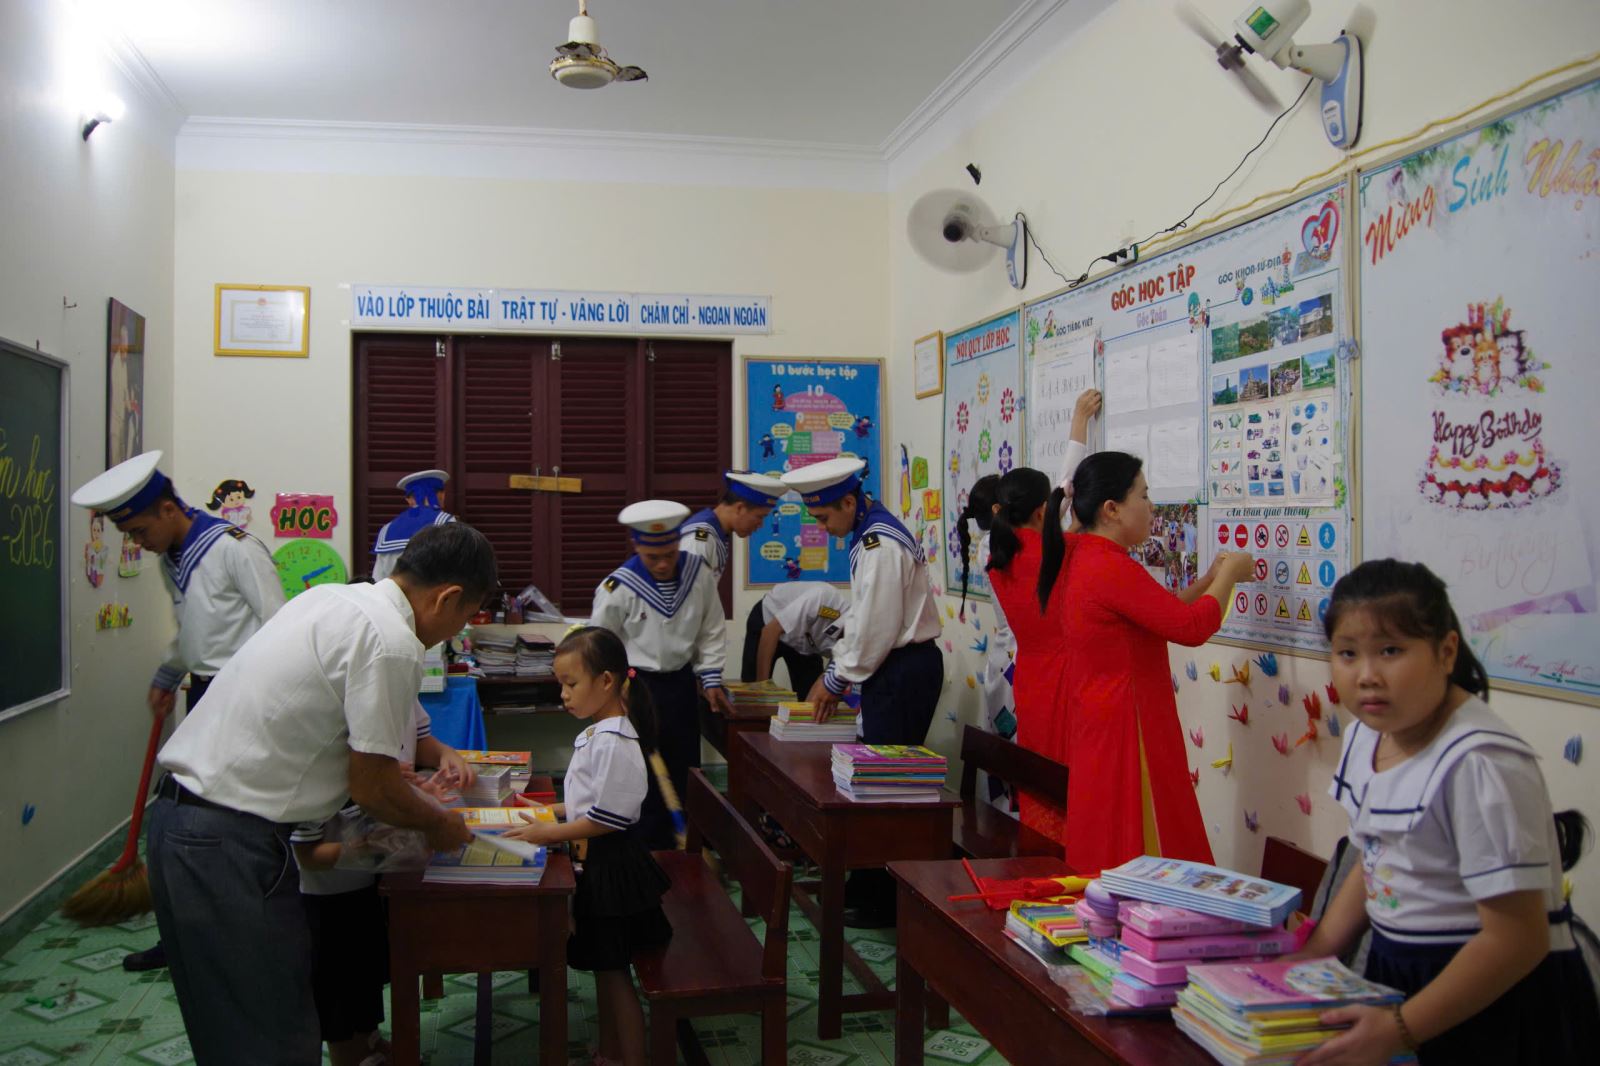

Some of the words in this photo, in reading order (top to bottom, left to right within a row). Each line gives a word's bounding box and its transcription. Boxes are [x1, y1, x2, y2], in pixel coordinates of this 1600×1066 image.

[1365, 184, 1435, 266] Mừng
[1449, 143, 1509, 212] Sinh
[1526, 138, 1600, 211] Nhậ
[1111, 284, 1135, 312] GÓC
[1138, 277, 1164, 303] HỌC
[1168, 263, 1196, 294] TẬP
[358, 291, 384, 317] VÀO
[389, 290, 415, 317] LỚP
[418, 292, 462, 322] THUỘC
[467, 293, 489, 319] BÀI
[502, 296, 535, 323] TRẬT
[540, 298, 559, 324] TỰ
[570, 298, 605, 321] VÂNG
[609, 299, 629, 323] LỜI
[641, 301, 669, 324] CHĂM
[672, 298, 690, 324] CHỈ
[699, 306, 730, 325] NGOAN
[734, 302, 766, 326] NGOÃN
[956, 340, 967, 361] NỘI
[968, 336, 982, 359] QUY
[983, 329, 994, 351] LỚP
[996, 326, 1010, 348] HỌC
[770, 364, 785, 376] 10
[788, 364, 814, 376] bước
[817, 365, 836, 379] học
[839, 365, 858, 380] tập
[807, 384, 824, 397] 10
[1432, 410, 1479, 458] Happy
